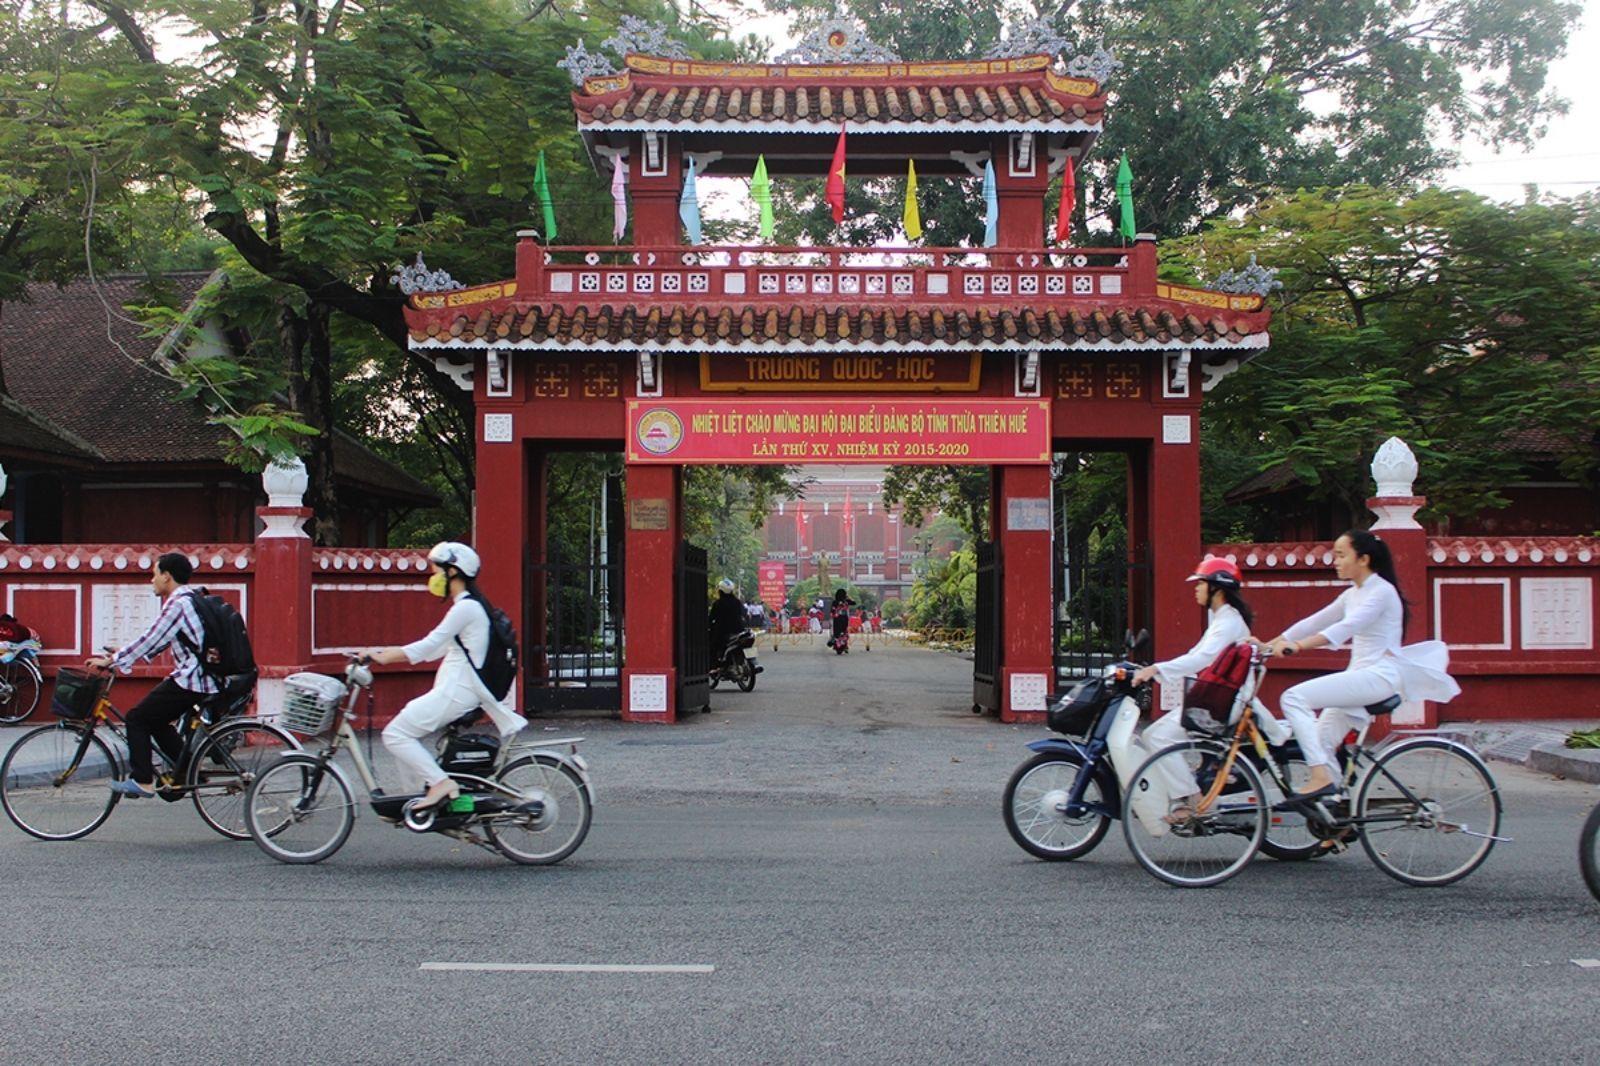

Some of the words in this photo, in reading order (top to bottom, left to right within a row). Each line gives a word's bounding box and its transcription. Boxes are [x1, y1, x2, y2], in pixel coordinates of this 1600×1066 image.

[692, 409, 720, 437] NHIỆT
[722, 409, 743, 437] LIỆT
[745, 409, 771, 433] CHÀO
[773, 409, 801, 433] MỪNG
[803, 414, 819, 437] ĐẠI
[821, 409, 838, 437] HỘI
[840, 414, 857, 437] ĐẠI
[859, 405, 881, 433] BIỂU
[883, 407, 909, 433] ĐẢNG
[911, 409, 925, 437] BỘ
[927, 407, 949, 433] TỈNH
[951, 409, 976, 433] THỪA
[978, 409, 1006, 433] THIÊN
[1008, 407, 1029, 433] HUẾ
[752, 437, 777, 455] LẦN
[781, 441, 808, 455] THỨ
[836, 440, 879, 457] NHIỆM
[883, 440, 900, 455] KỲ
[904, 443, 969, 455] 2015-2020
